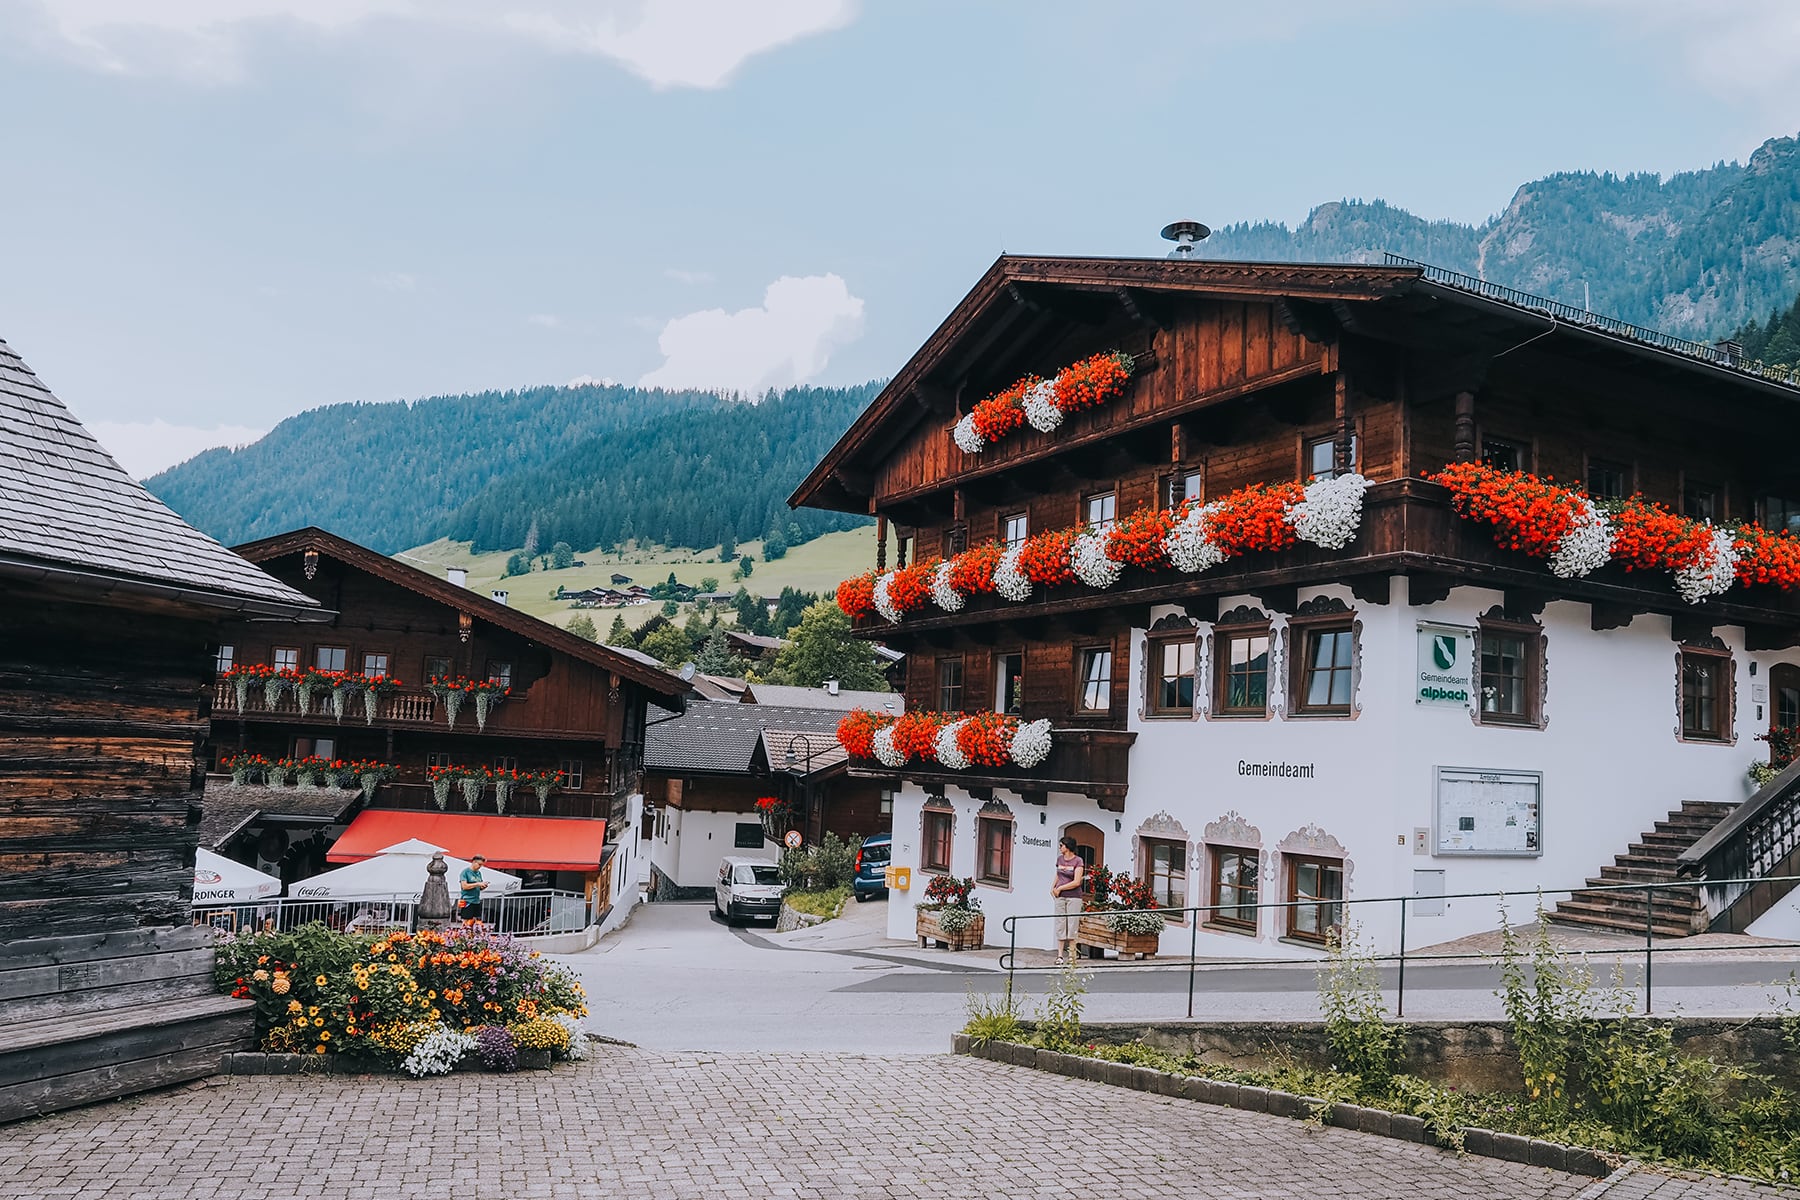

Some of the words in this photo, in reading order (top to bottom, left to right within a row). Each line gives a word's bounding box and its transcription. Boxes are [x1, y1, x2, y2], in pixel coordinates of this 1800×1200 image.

[1420, 671, 1469, 685] Gemeindeamt
[1421, 686, 1468, 701] alpbach
[1238, 760, 1314, 779] Gemeindeamt
[1022, 835, 1052, 848] Standesamt
[194, 889, 235, 901] RDINGER
